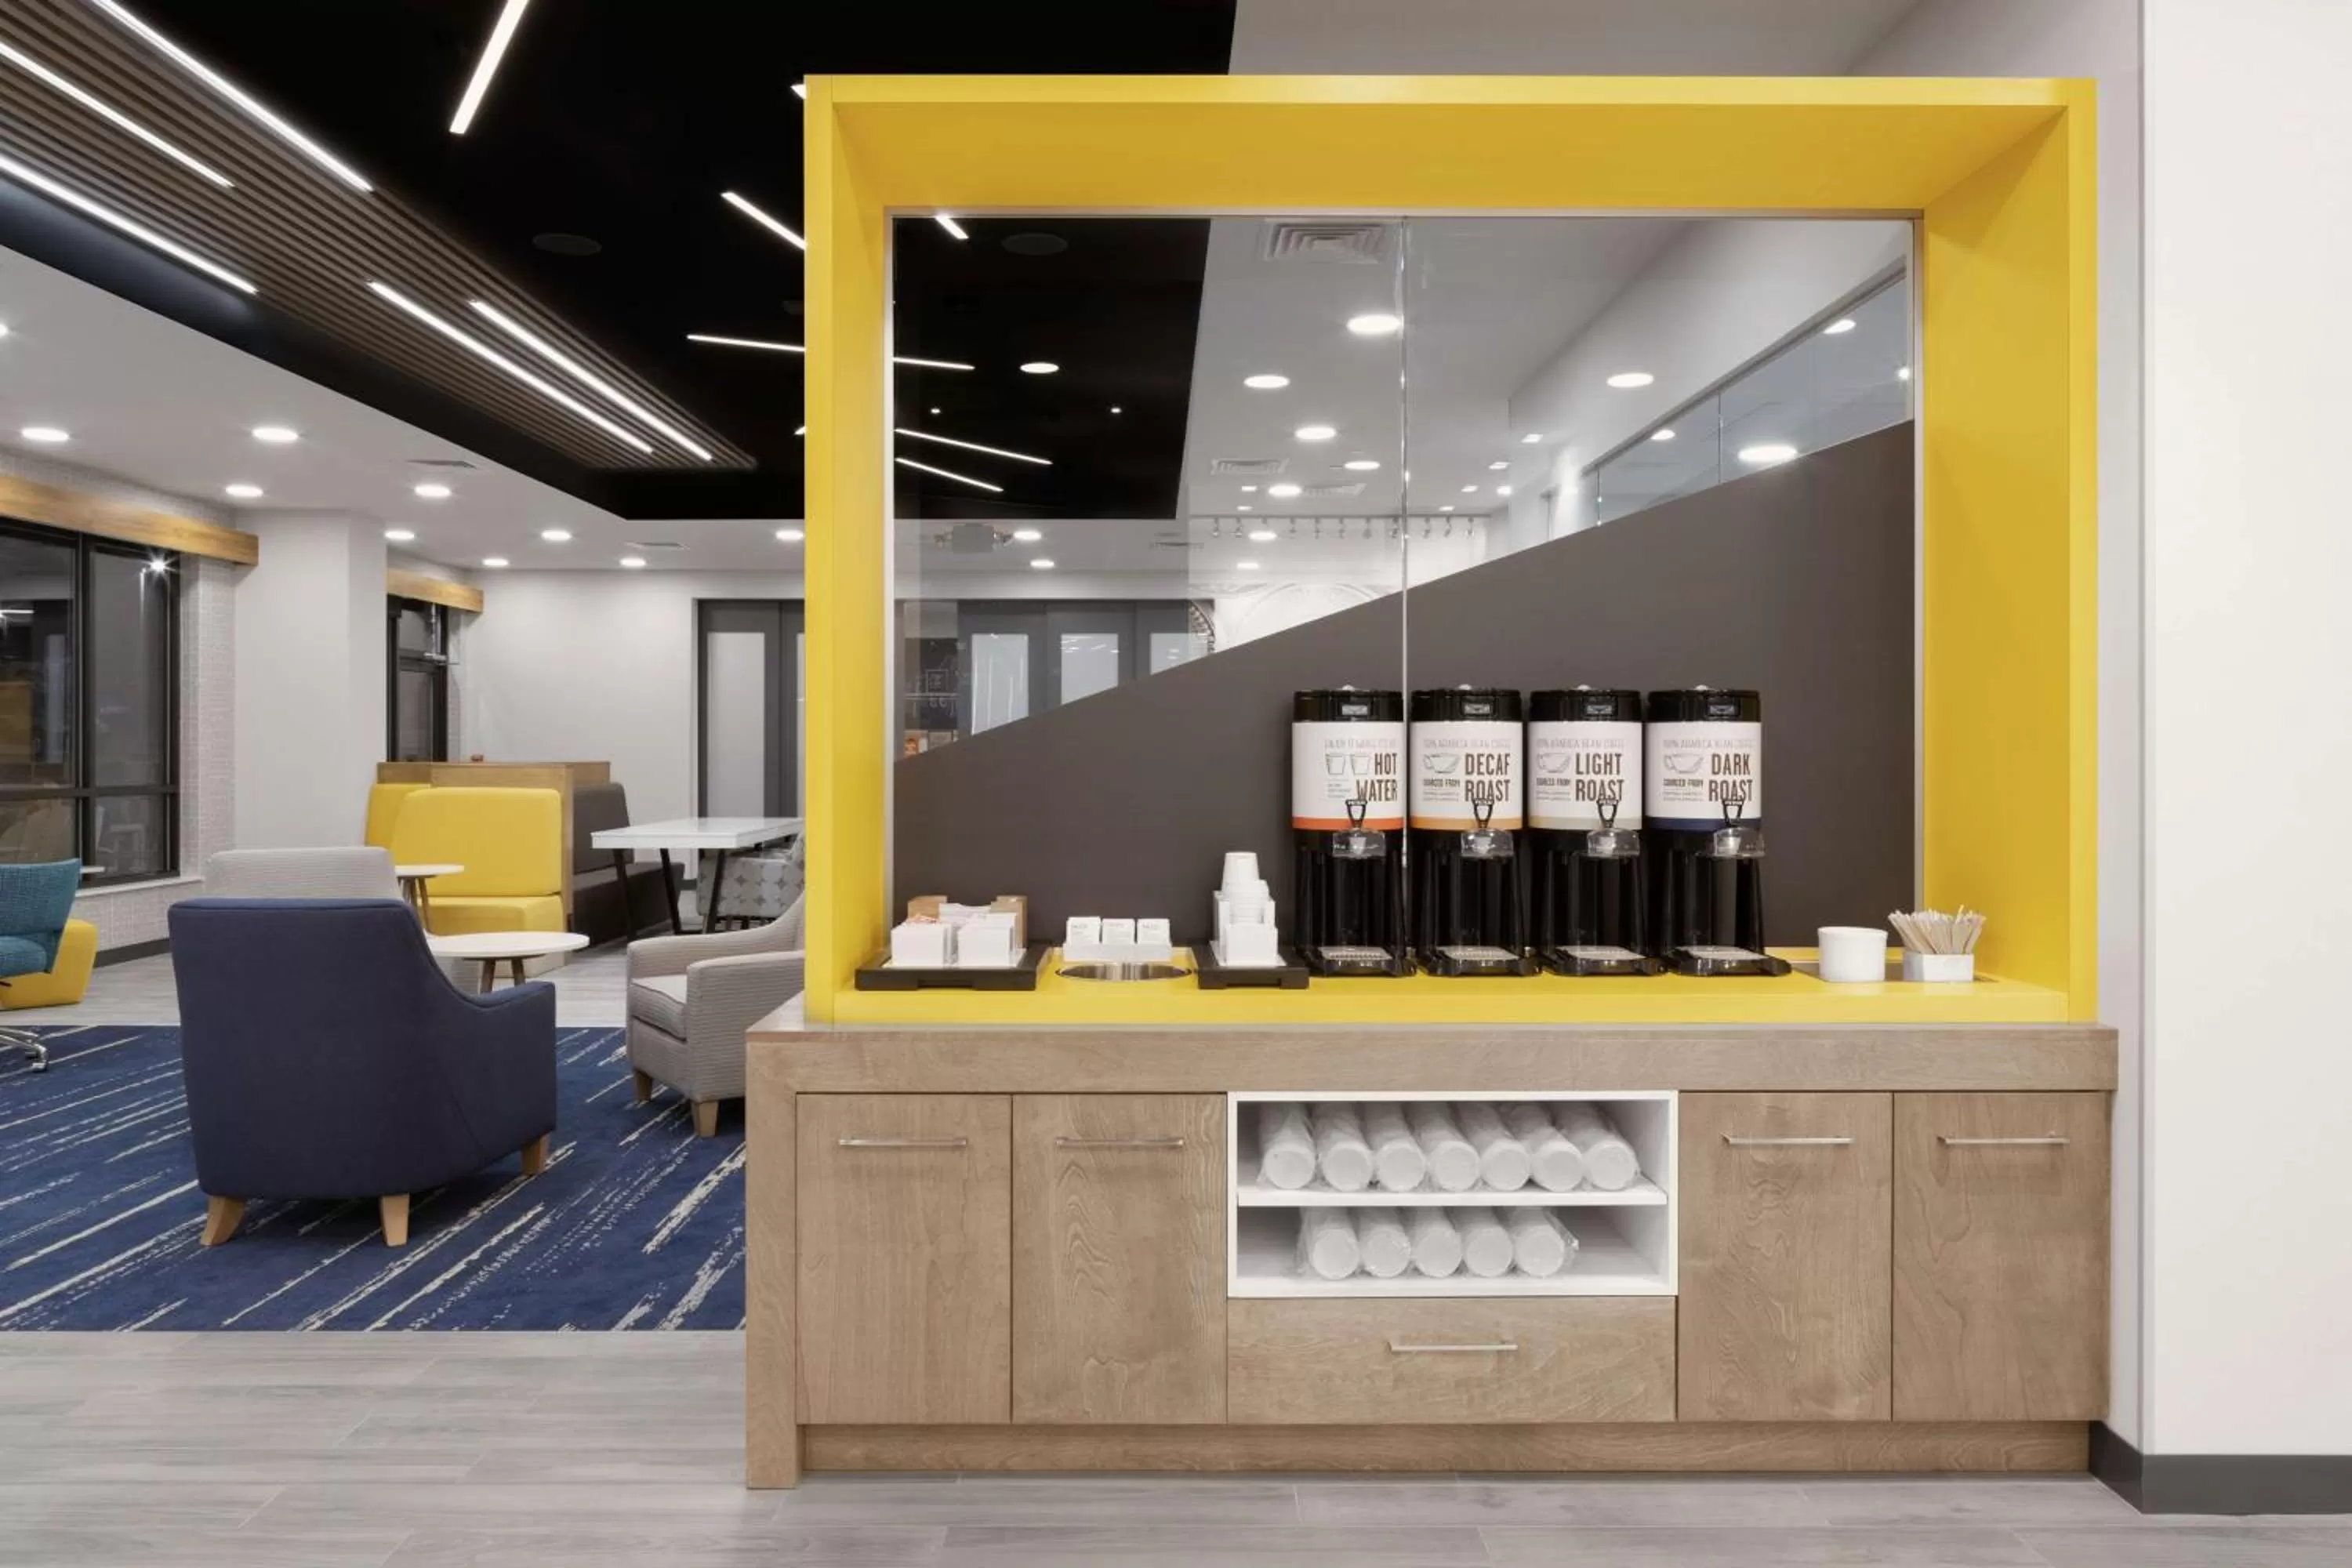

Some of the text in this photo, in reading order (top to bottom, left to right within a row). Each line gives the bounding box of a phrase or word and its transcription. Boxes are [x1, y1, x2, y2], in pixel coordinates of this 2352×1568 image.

[1374, 753, 1398, 775] HOT
[1465, 753, 1510, 775] DECAF
[1575, 753, 1622, 775] LIGHT
[1711, 753, 1751, 775] DARK
[1356, 779, 1398, 801] WATER
[1465, 779, 1510, 802] ROAST
[1575, 779, 1624, 801] ROAST
[1708, 779, 1753, 801] ROAST
